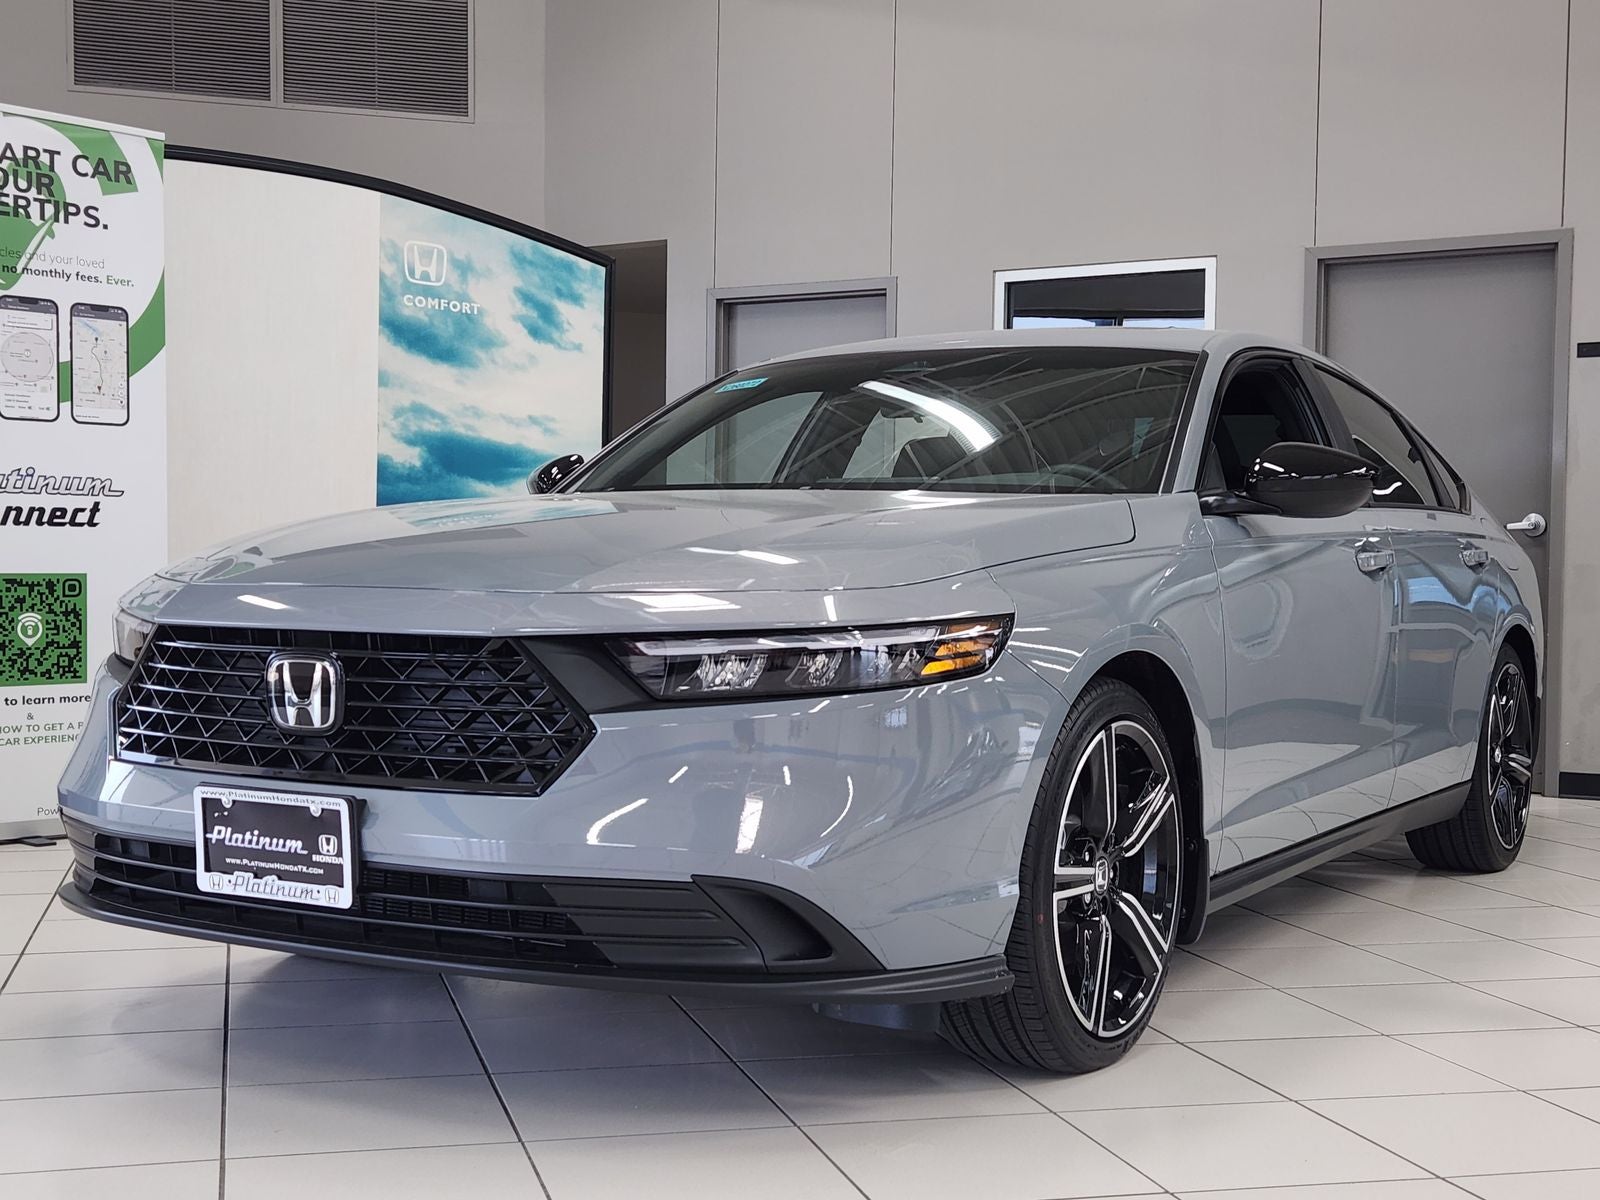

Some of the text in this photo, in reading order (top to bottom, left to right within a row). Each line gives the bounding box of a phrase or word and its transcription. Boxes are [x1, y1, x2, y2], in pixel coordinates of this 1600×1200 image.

[72, 154, 133, 185] CAR
[24, 251, 46, 262] and
[49, 254, 73, 266] your
[76, 255, 105, 269] loved
[2, 264, 135, 287] no monthly fees. Ever.
[403, 294, 480, 315] COMFORT
[4, 694, 92, 706] to learn more
[26, 712, 34, 721] &
[26, 723, 40, 733] TO
[43, 722, 64, 732] GET
[67, 722, 75, 730] A
[206, 825, 308, 855] Platinum
[312, 854, 344, 865] HONDA
[231, 874, 321, 901] Platinum
